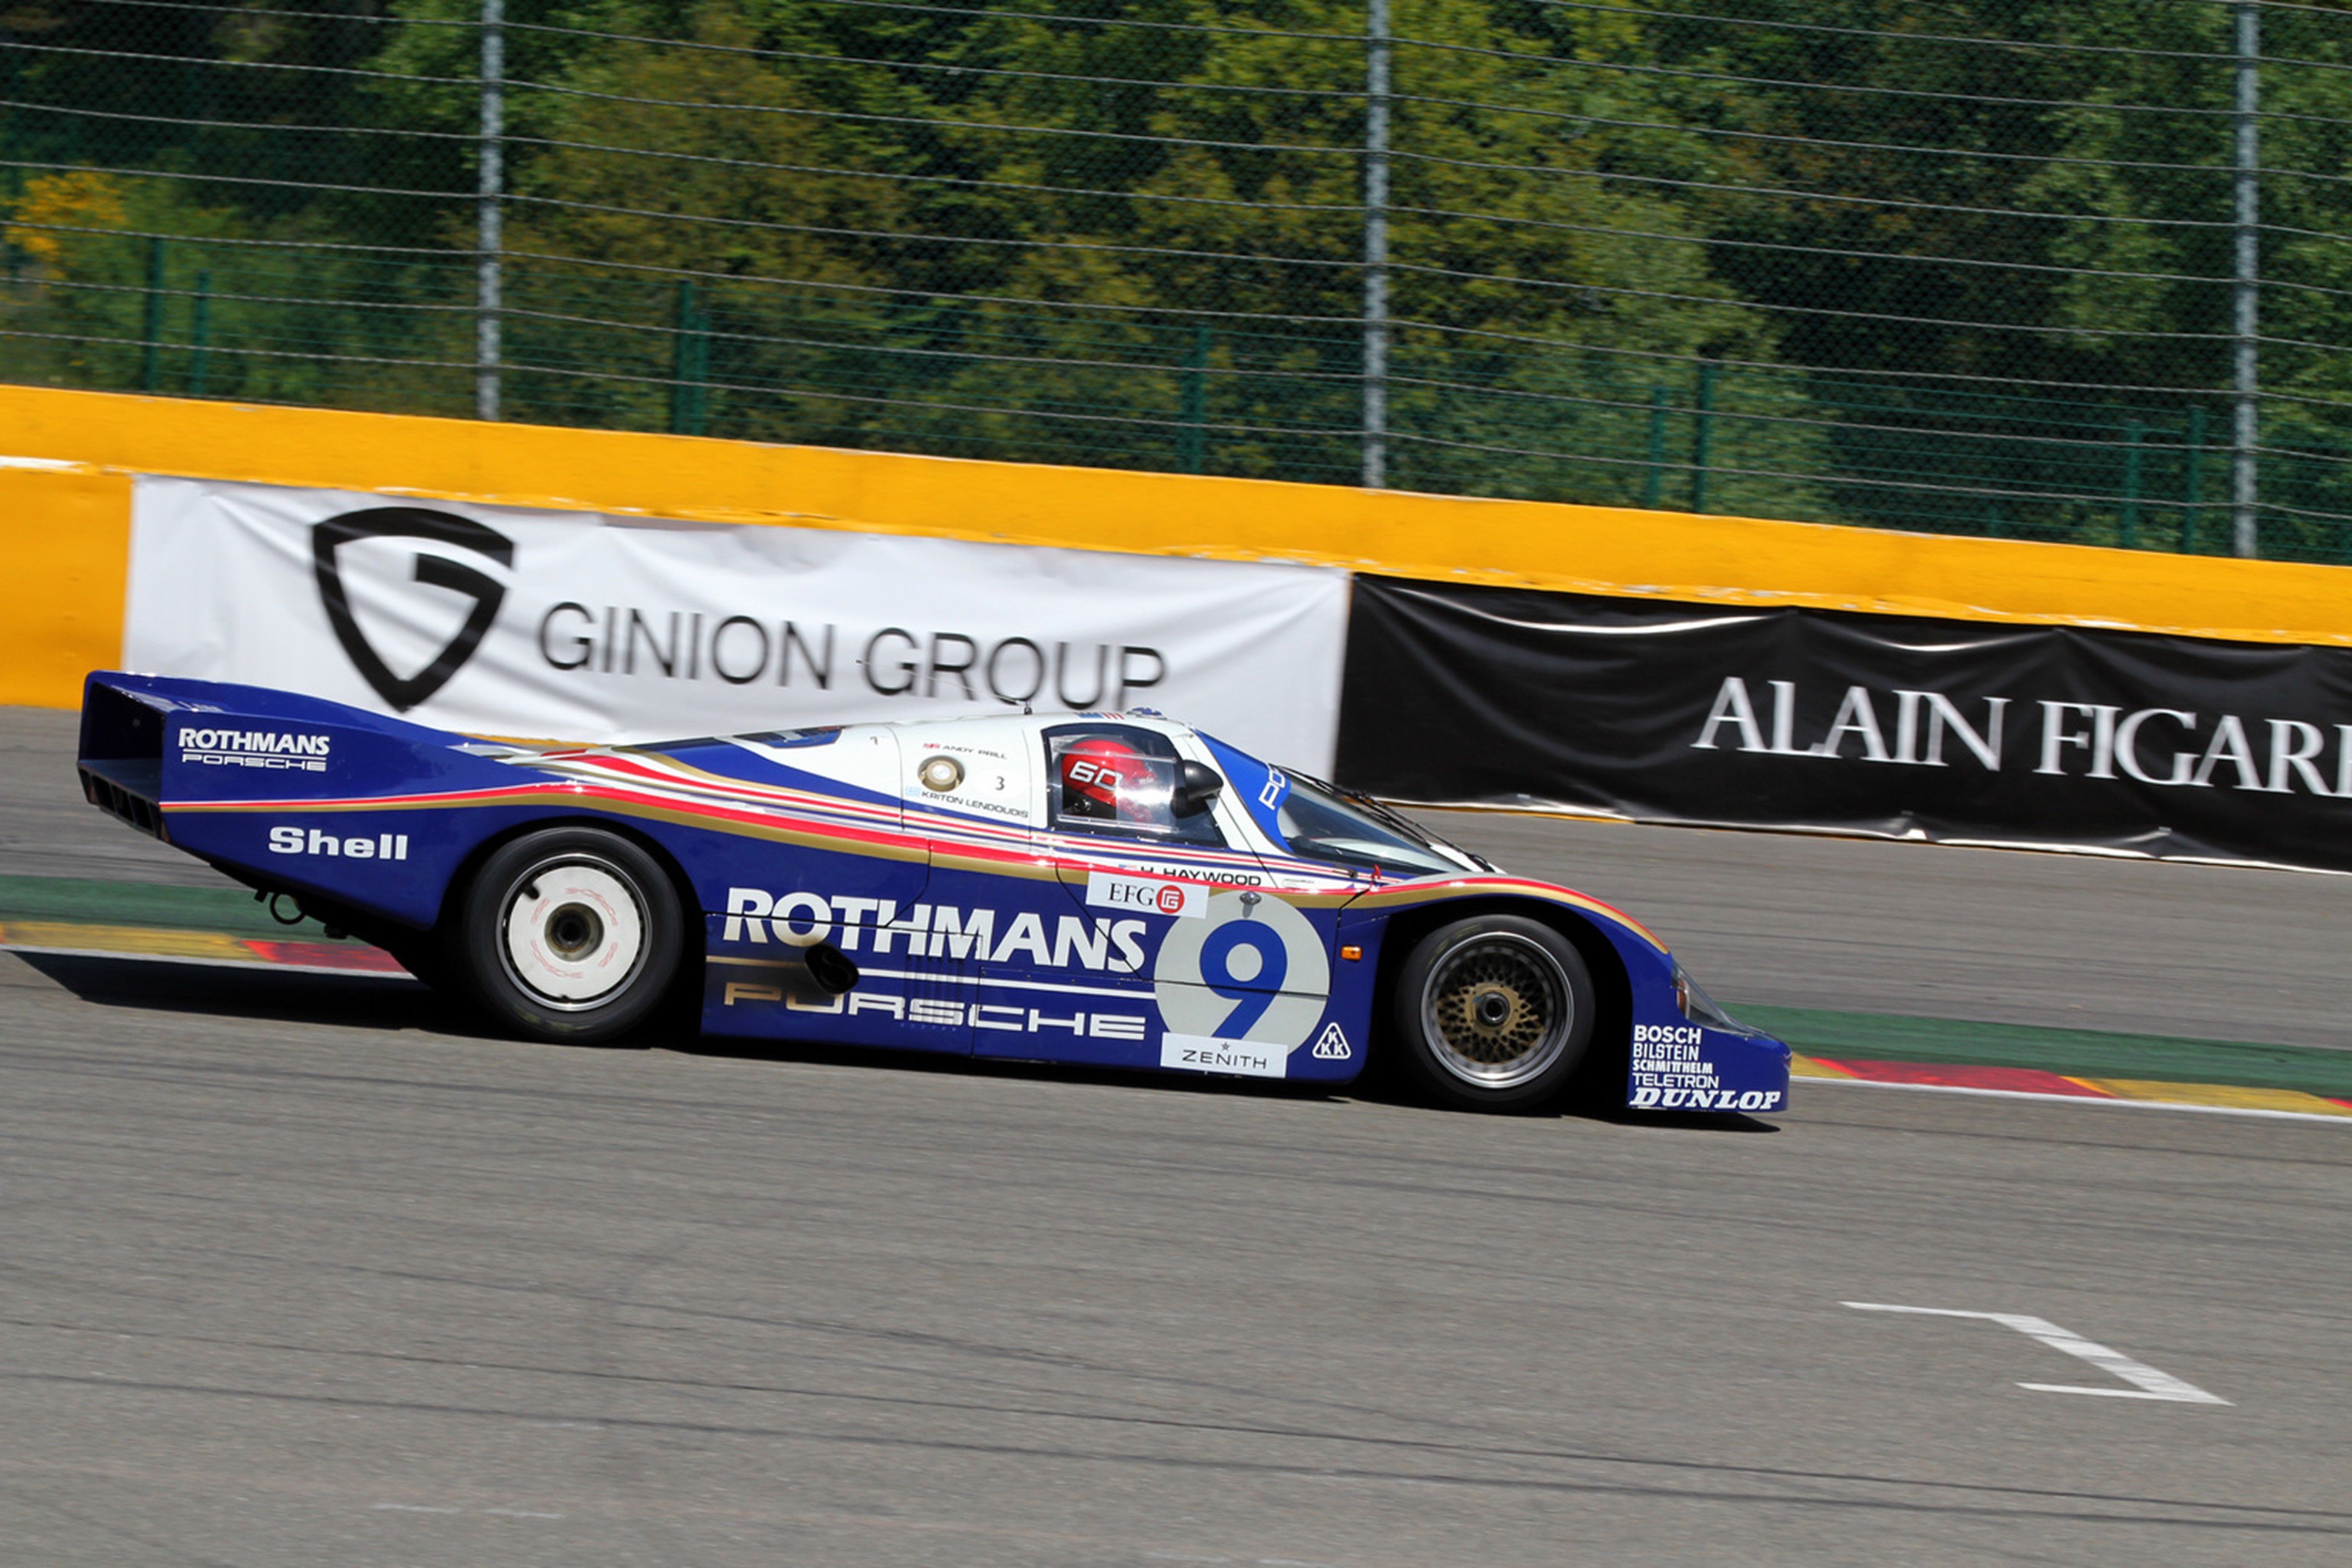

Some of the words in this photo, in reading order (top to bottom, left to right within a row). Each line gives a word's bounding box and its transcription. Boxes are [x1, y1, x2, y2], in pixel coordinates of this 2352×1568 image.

[538, 601, 836, 690] GINION
[863, 627, 1167, 713] GROUP
[1690, 676, 2012, 771] ALAIN
[179, 728, 329, 754] ROTHMANS
[182, 754, 326, 771] PORSCHE
[995, 775, 1005, 791] 3
[1069, 760, 1124, 792] 60
[921, 791, 964, 805] KRITON
[268, 826, 408, 861] Shell
[1163, 868, 1261, 886] HAYWOOD
[1108, 882, 1155, 907] EFG
[723, 887, 1147, 974] ROTHMANS
[1200, 920, 1287, 1039] 9
[724, 982, 1146, 1040] PORSCHE
[1634, 1025, 1701, 1044] BOSCH
[1182, 1049, 1267, 1070] ZENITH
[1633, 1044, 1699, 1061] BILSTEIN
[1632, 1059, 1712, 1074] SCHMITTHELM
[1632, 1073, 1719, 1088] TELETRON
[1629, 1087, 1780, 1109] DUNLOP
